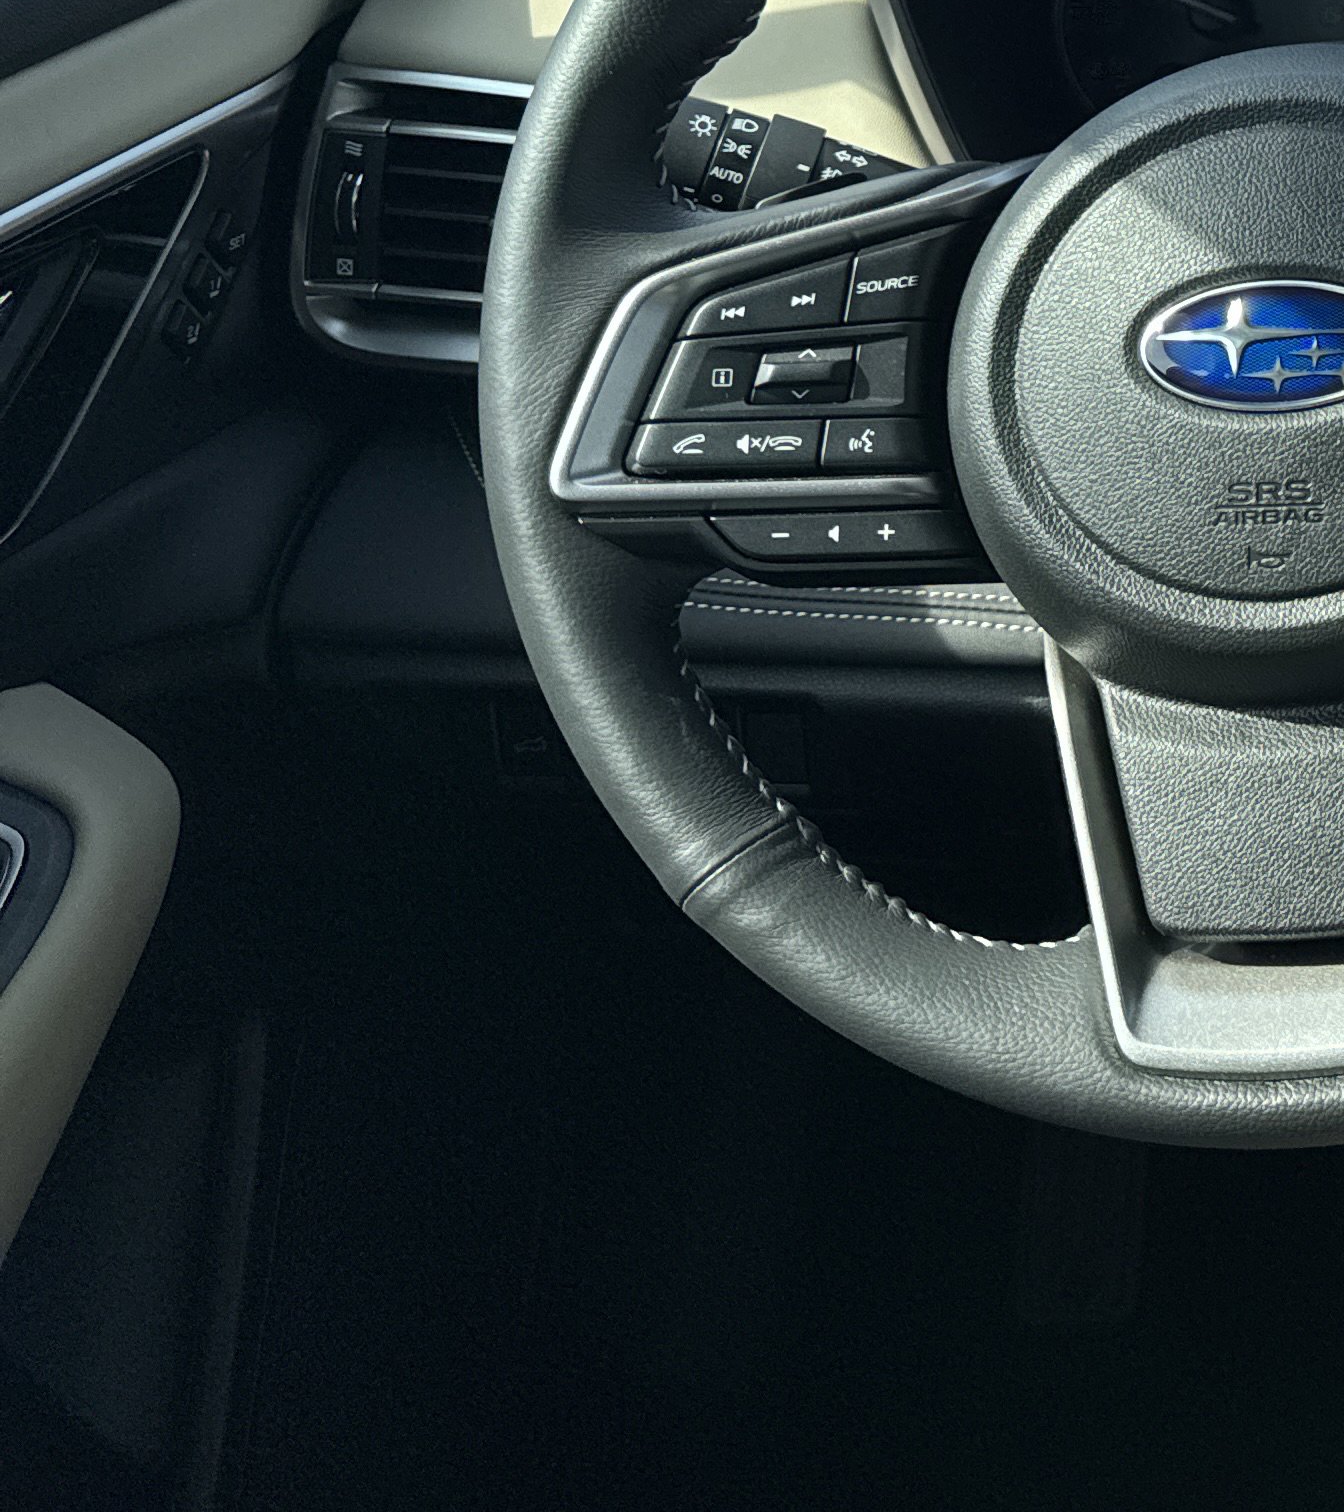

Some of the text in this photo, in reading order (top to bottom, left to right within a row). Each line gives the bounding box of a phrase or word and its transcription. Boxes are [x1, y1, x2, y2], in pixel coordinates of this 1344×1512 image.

[710, 166, 744, 184] AUTO
[855, 274, 920, 295] SOURCE
[1228, 479, 1312, 503] SRS
[1212, 508, 1324, 526] AIRBAG
